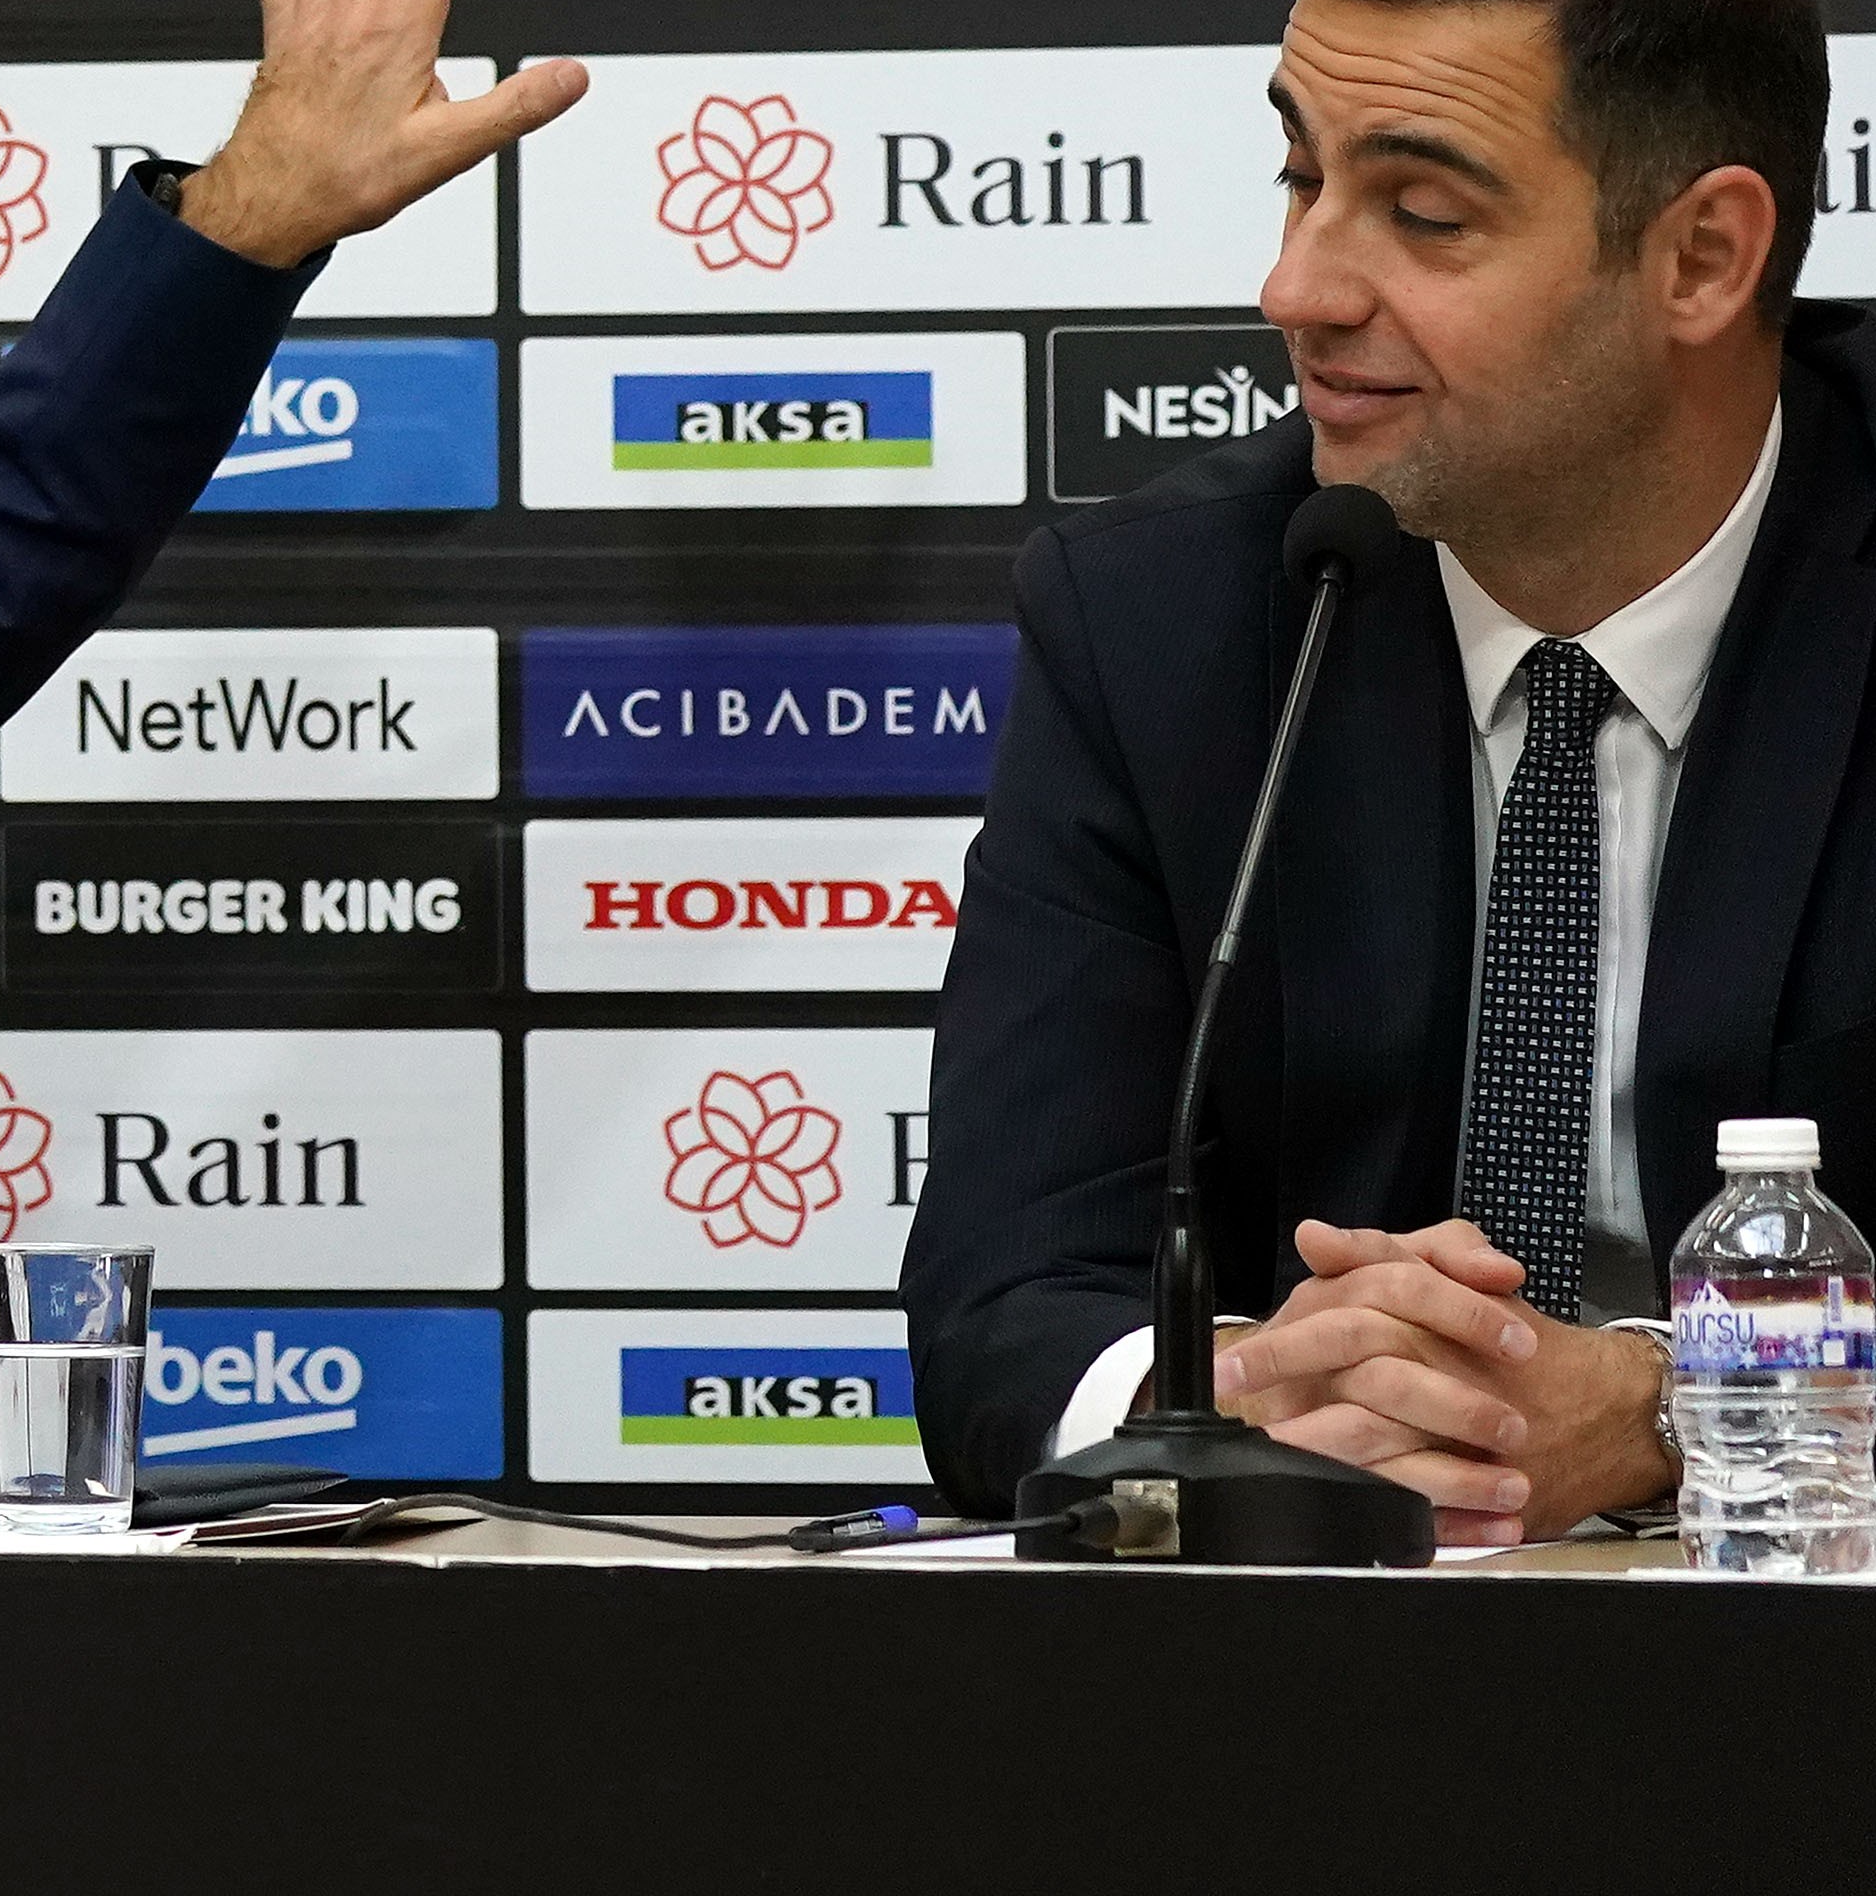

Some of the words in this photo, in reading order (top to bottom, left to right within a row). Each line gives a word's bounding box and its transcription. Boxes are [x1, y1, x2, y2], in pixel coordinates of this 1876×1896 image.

[879, 131, 1148, 228] Rain
[676, 400, 872, 446] aksa
[78, 677, 416, 753] NetWork
[564, 687, 987, 737] ACIBADEM
[35, 879, 288, 934] BURGER
[302, 878, 461, 933] KING
[578, 874, 960, 934] HONDA
[96, 1112, 365, 1208] Rain
[148, 1330, 362, 1405] beko
[688, 1370, 877, 1420] aksa
